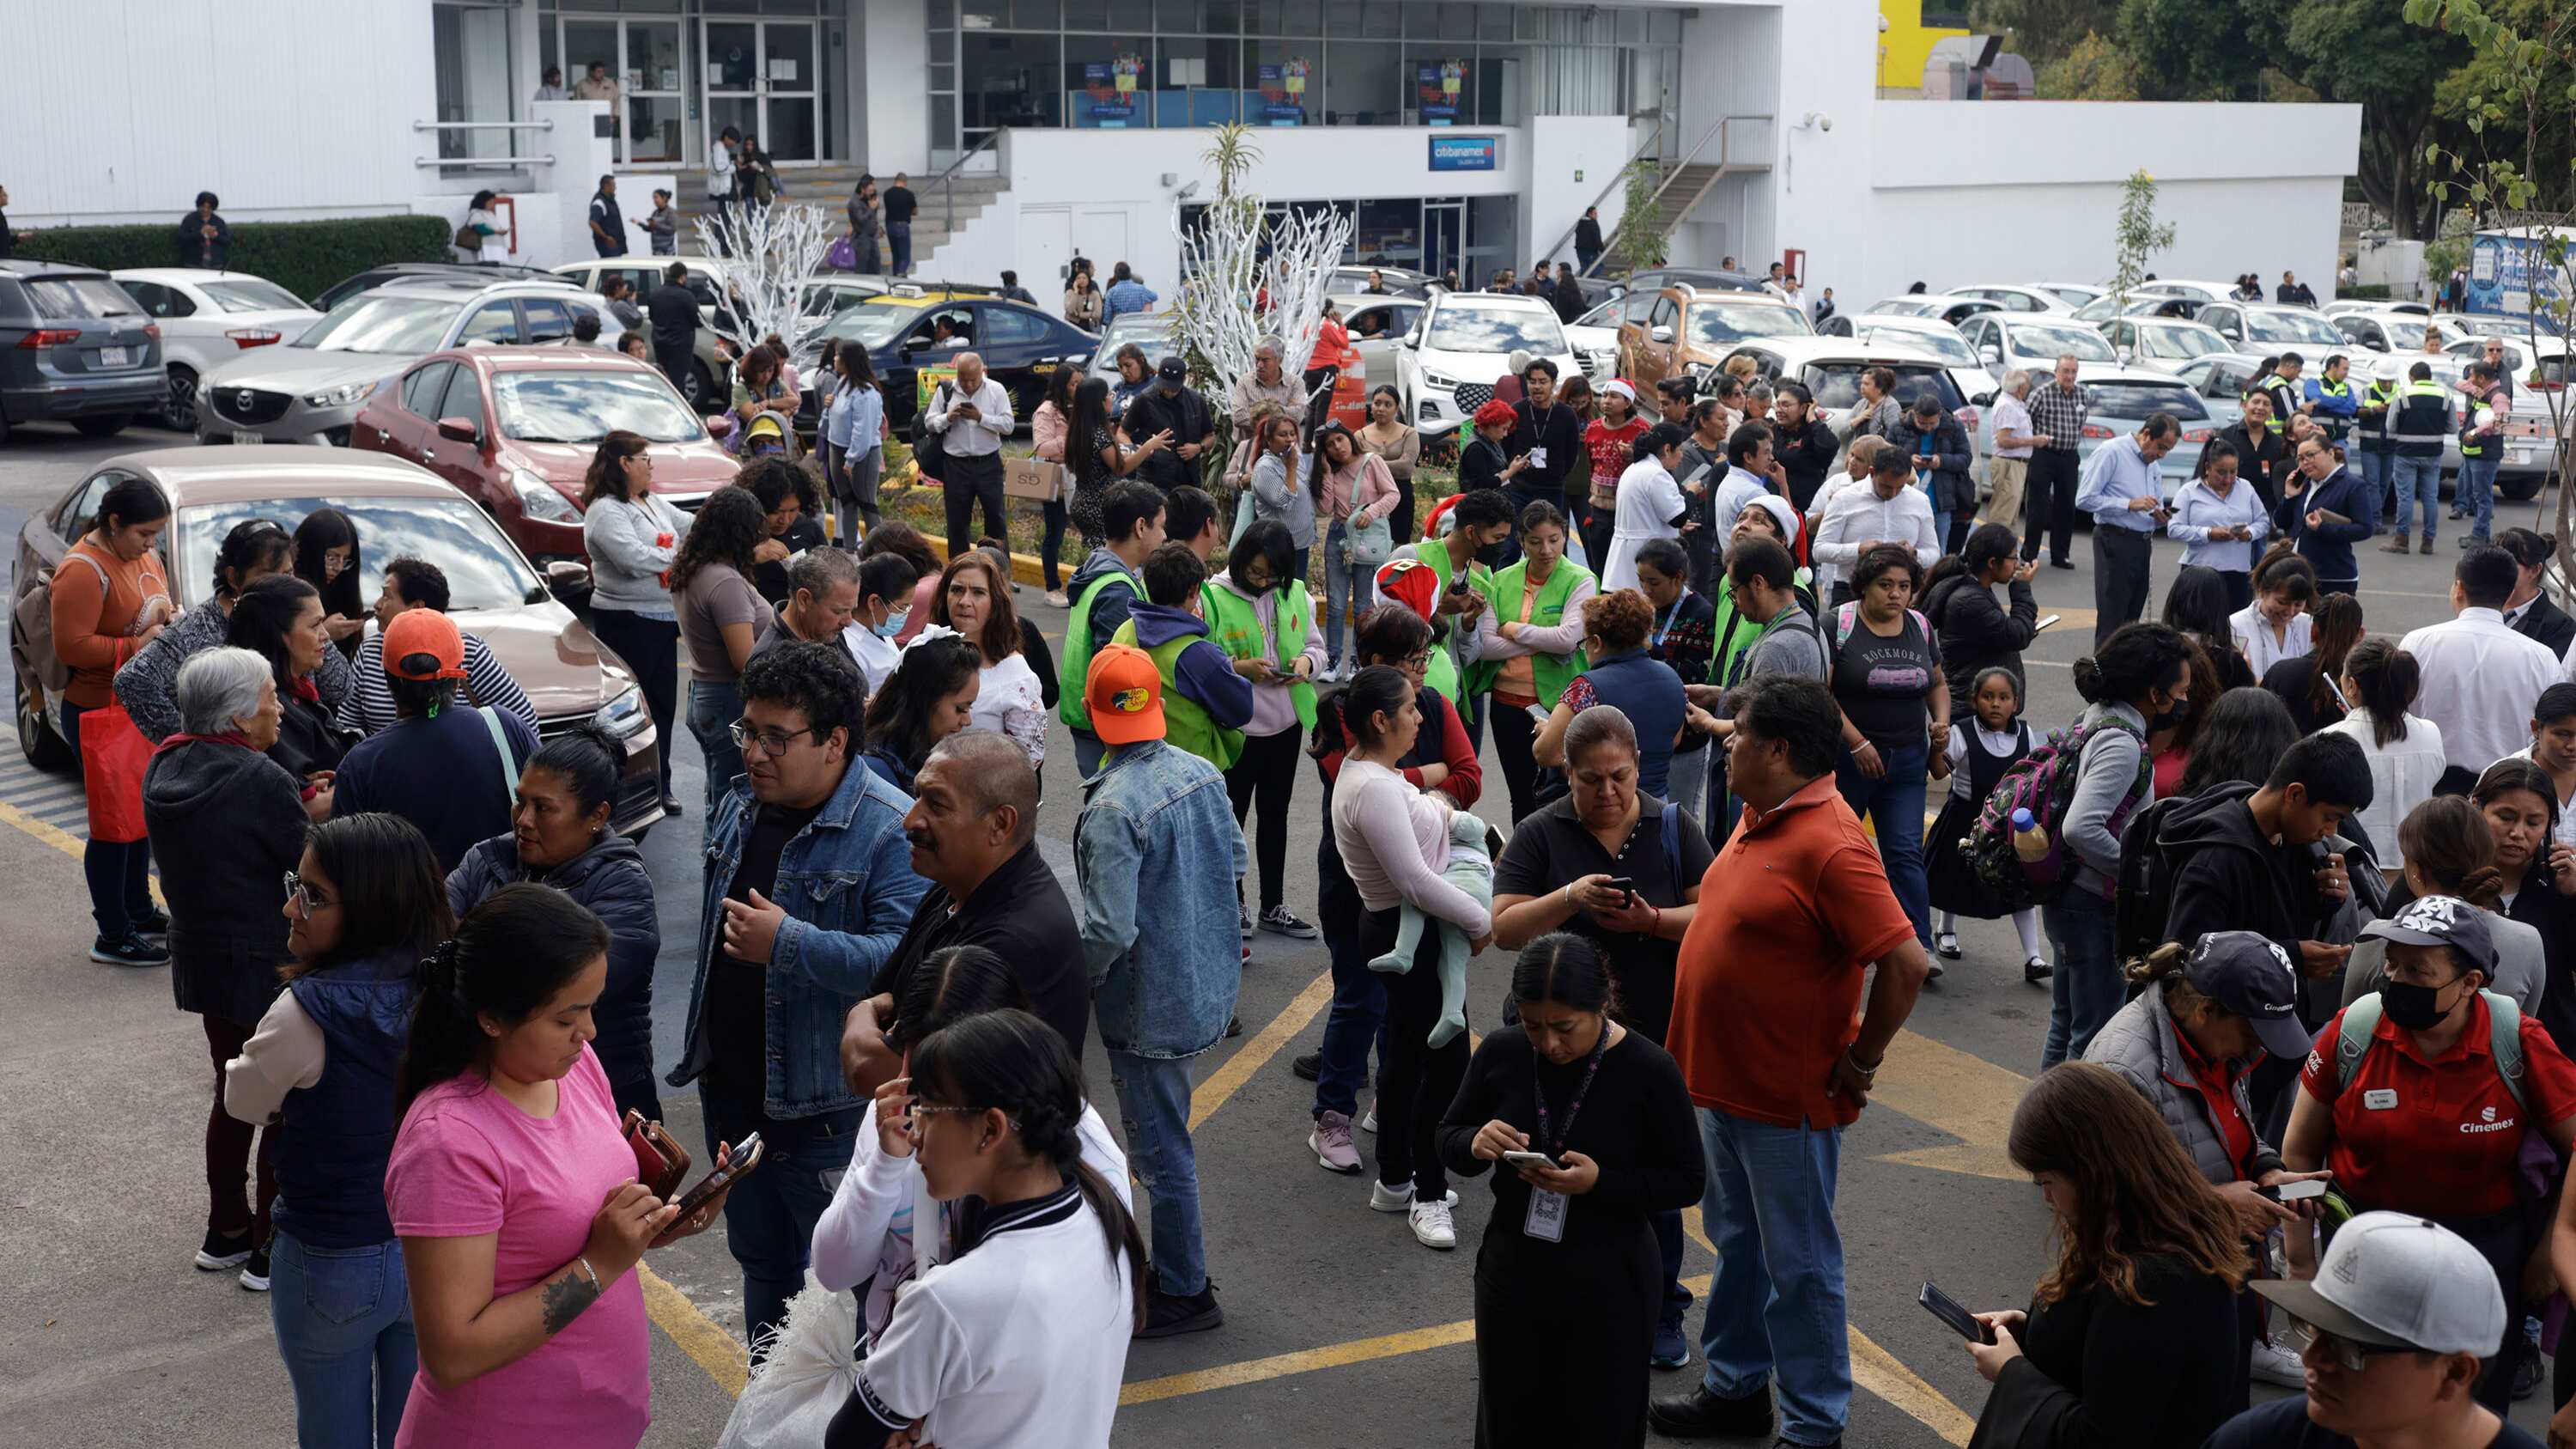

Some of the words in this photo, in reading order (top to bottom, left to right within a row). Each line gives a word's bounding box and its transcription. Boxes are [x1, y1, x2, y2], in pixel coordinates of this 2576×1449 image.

[1862, 648, 1923, 663] ROCKMORE
[2264, 1002, 2294, 1013] Cinemex
[2459, 1117, 2514, 1133] Cinemex
